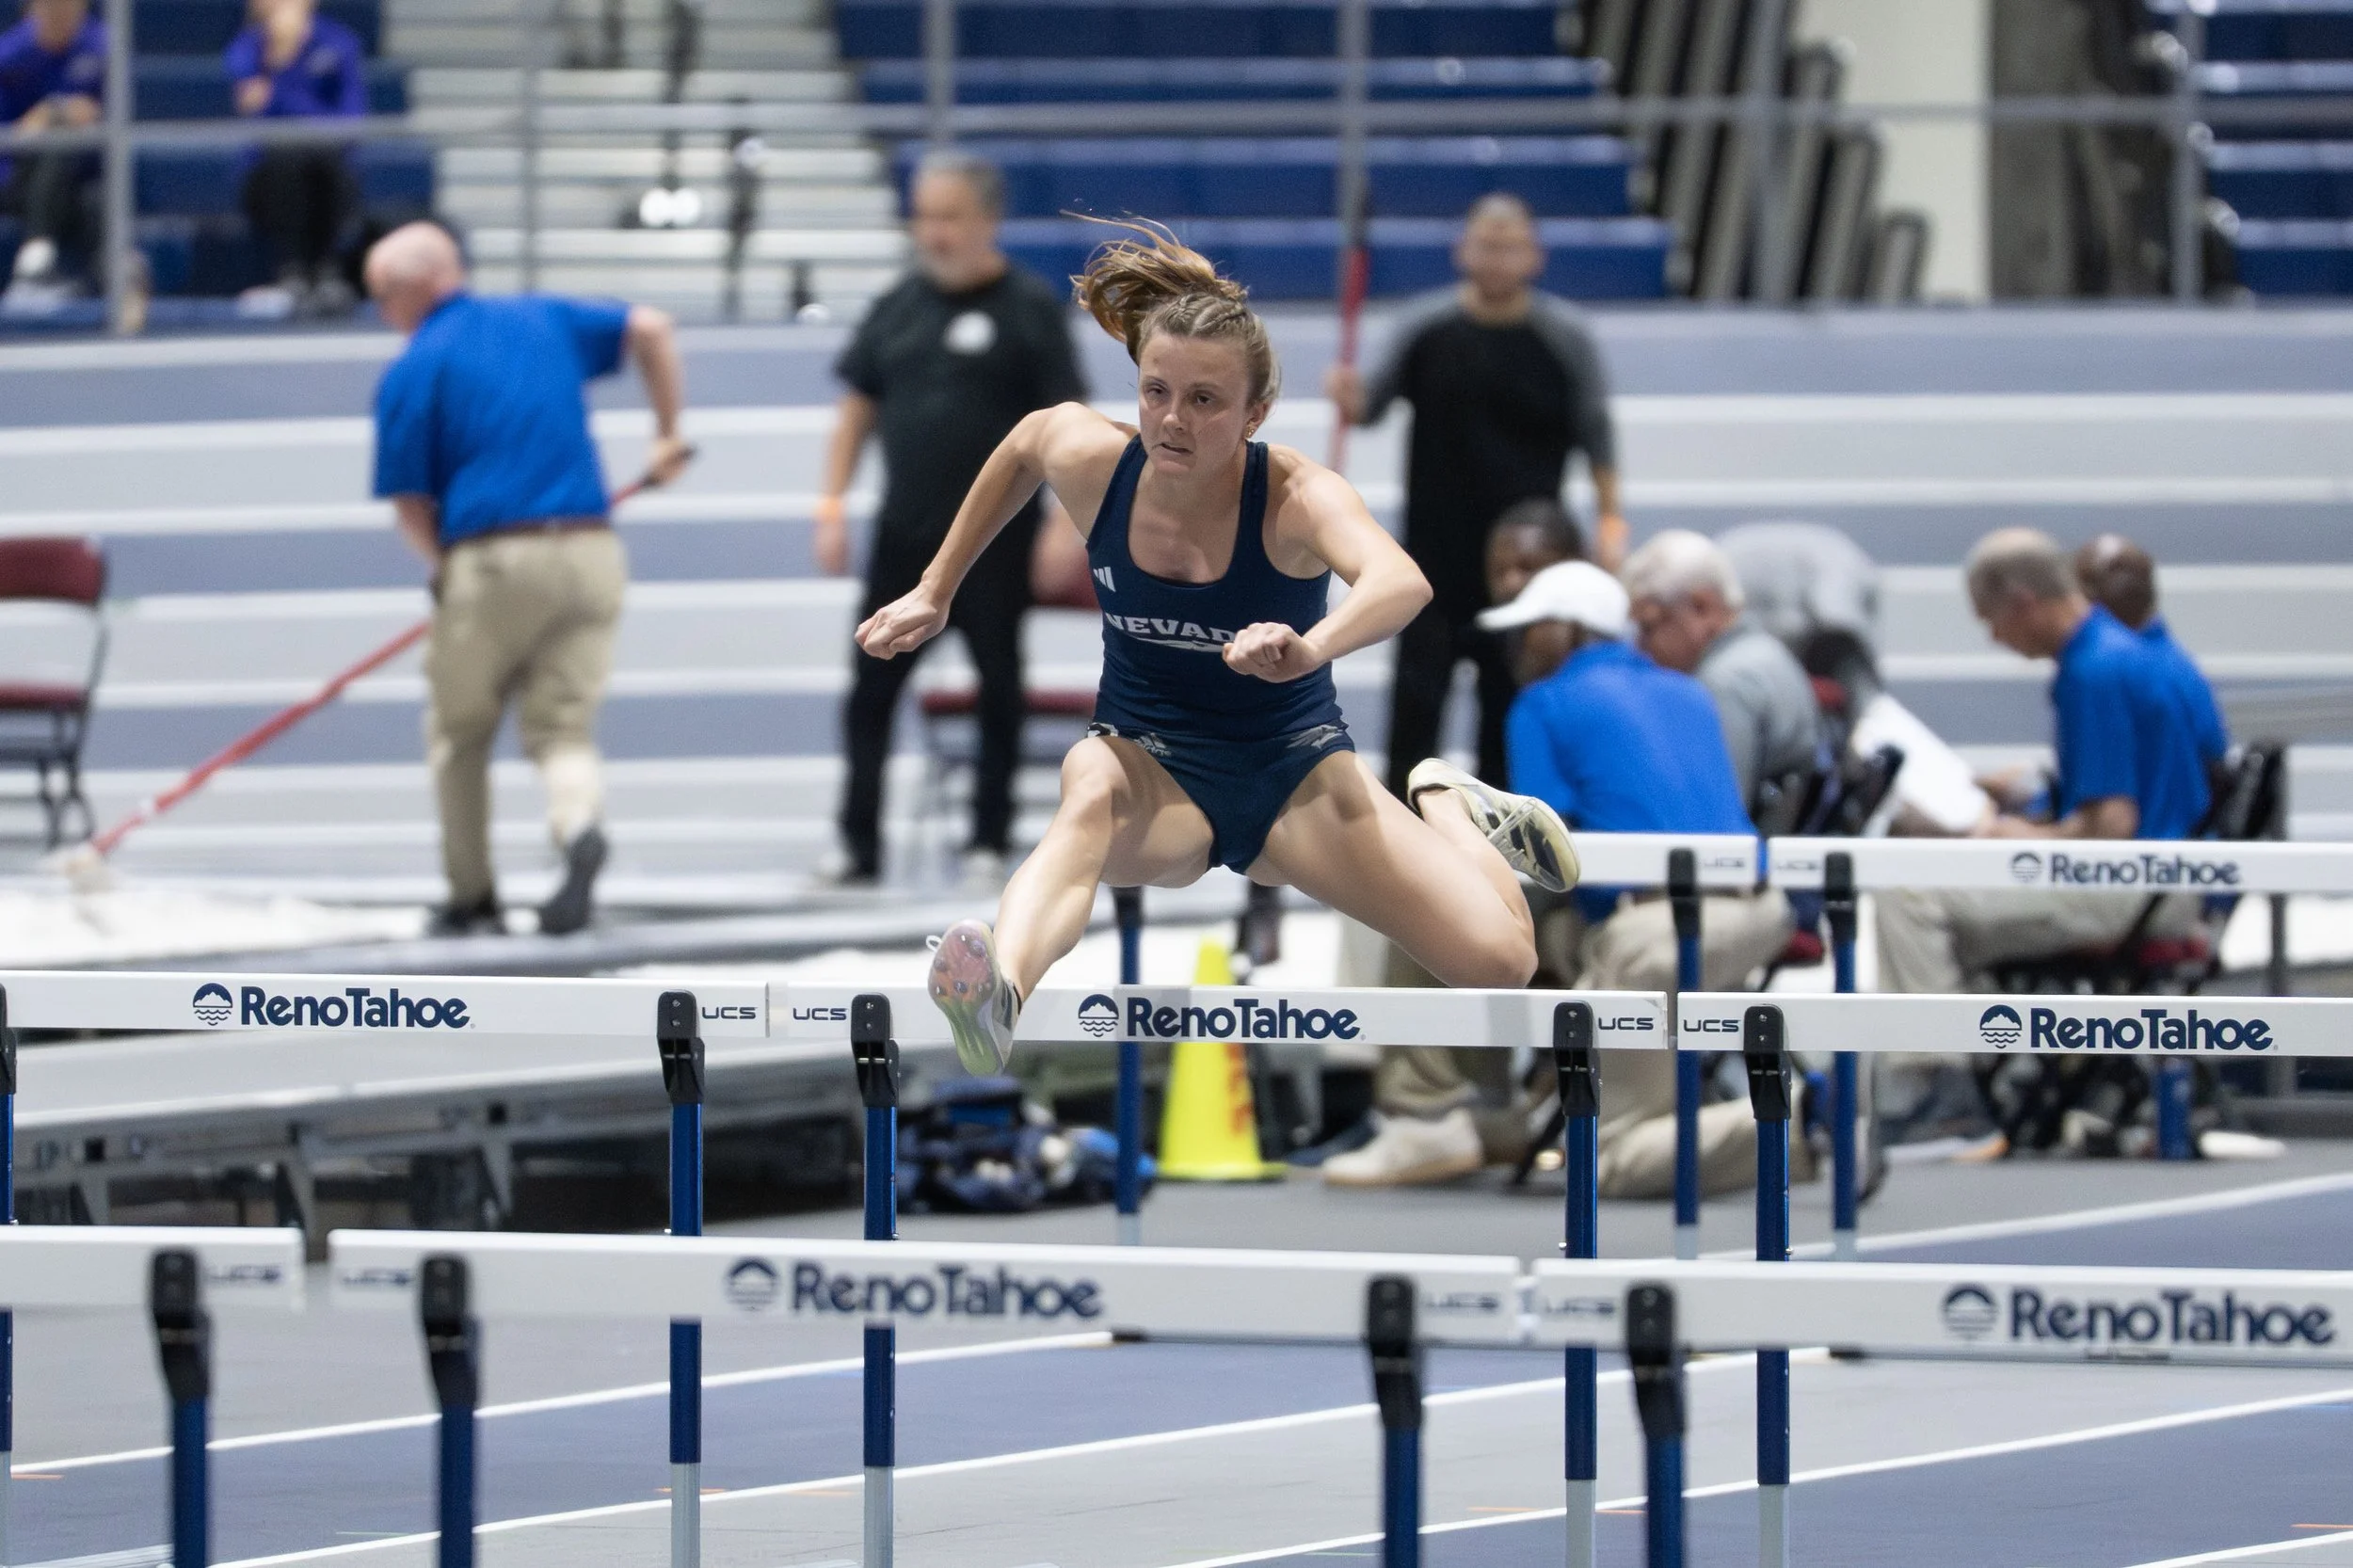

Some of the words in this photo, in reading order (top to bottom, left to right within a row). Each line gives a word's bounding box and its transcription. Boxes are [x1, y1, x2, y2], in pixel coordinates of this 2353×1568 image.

[1105, 612, 1238, 643] NEVAD
[2049, 853, 2241, 886] RenoTahoe
[241, 985, 471, 1029] RenoTahoe
[702, 1006, 758, 1019] UCS
[793, 1007, 847, 1021] UCS
[1127, 997, 1361, 1039] RenoTahoe
[1598, 1017, 1655, 1031] UCS
[1684, 1019, 1740, 1032] UCS
[2030, 1007, 2274, 1051] RenoTahoe
[792, 1260, 1103, 1319] RenoTahoe
[2009, 1287, 2336, 1346] RenoTahoe
